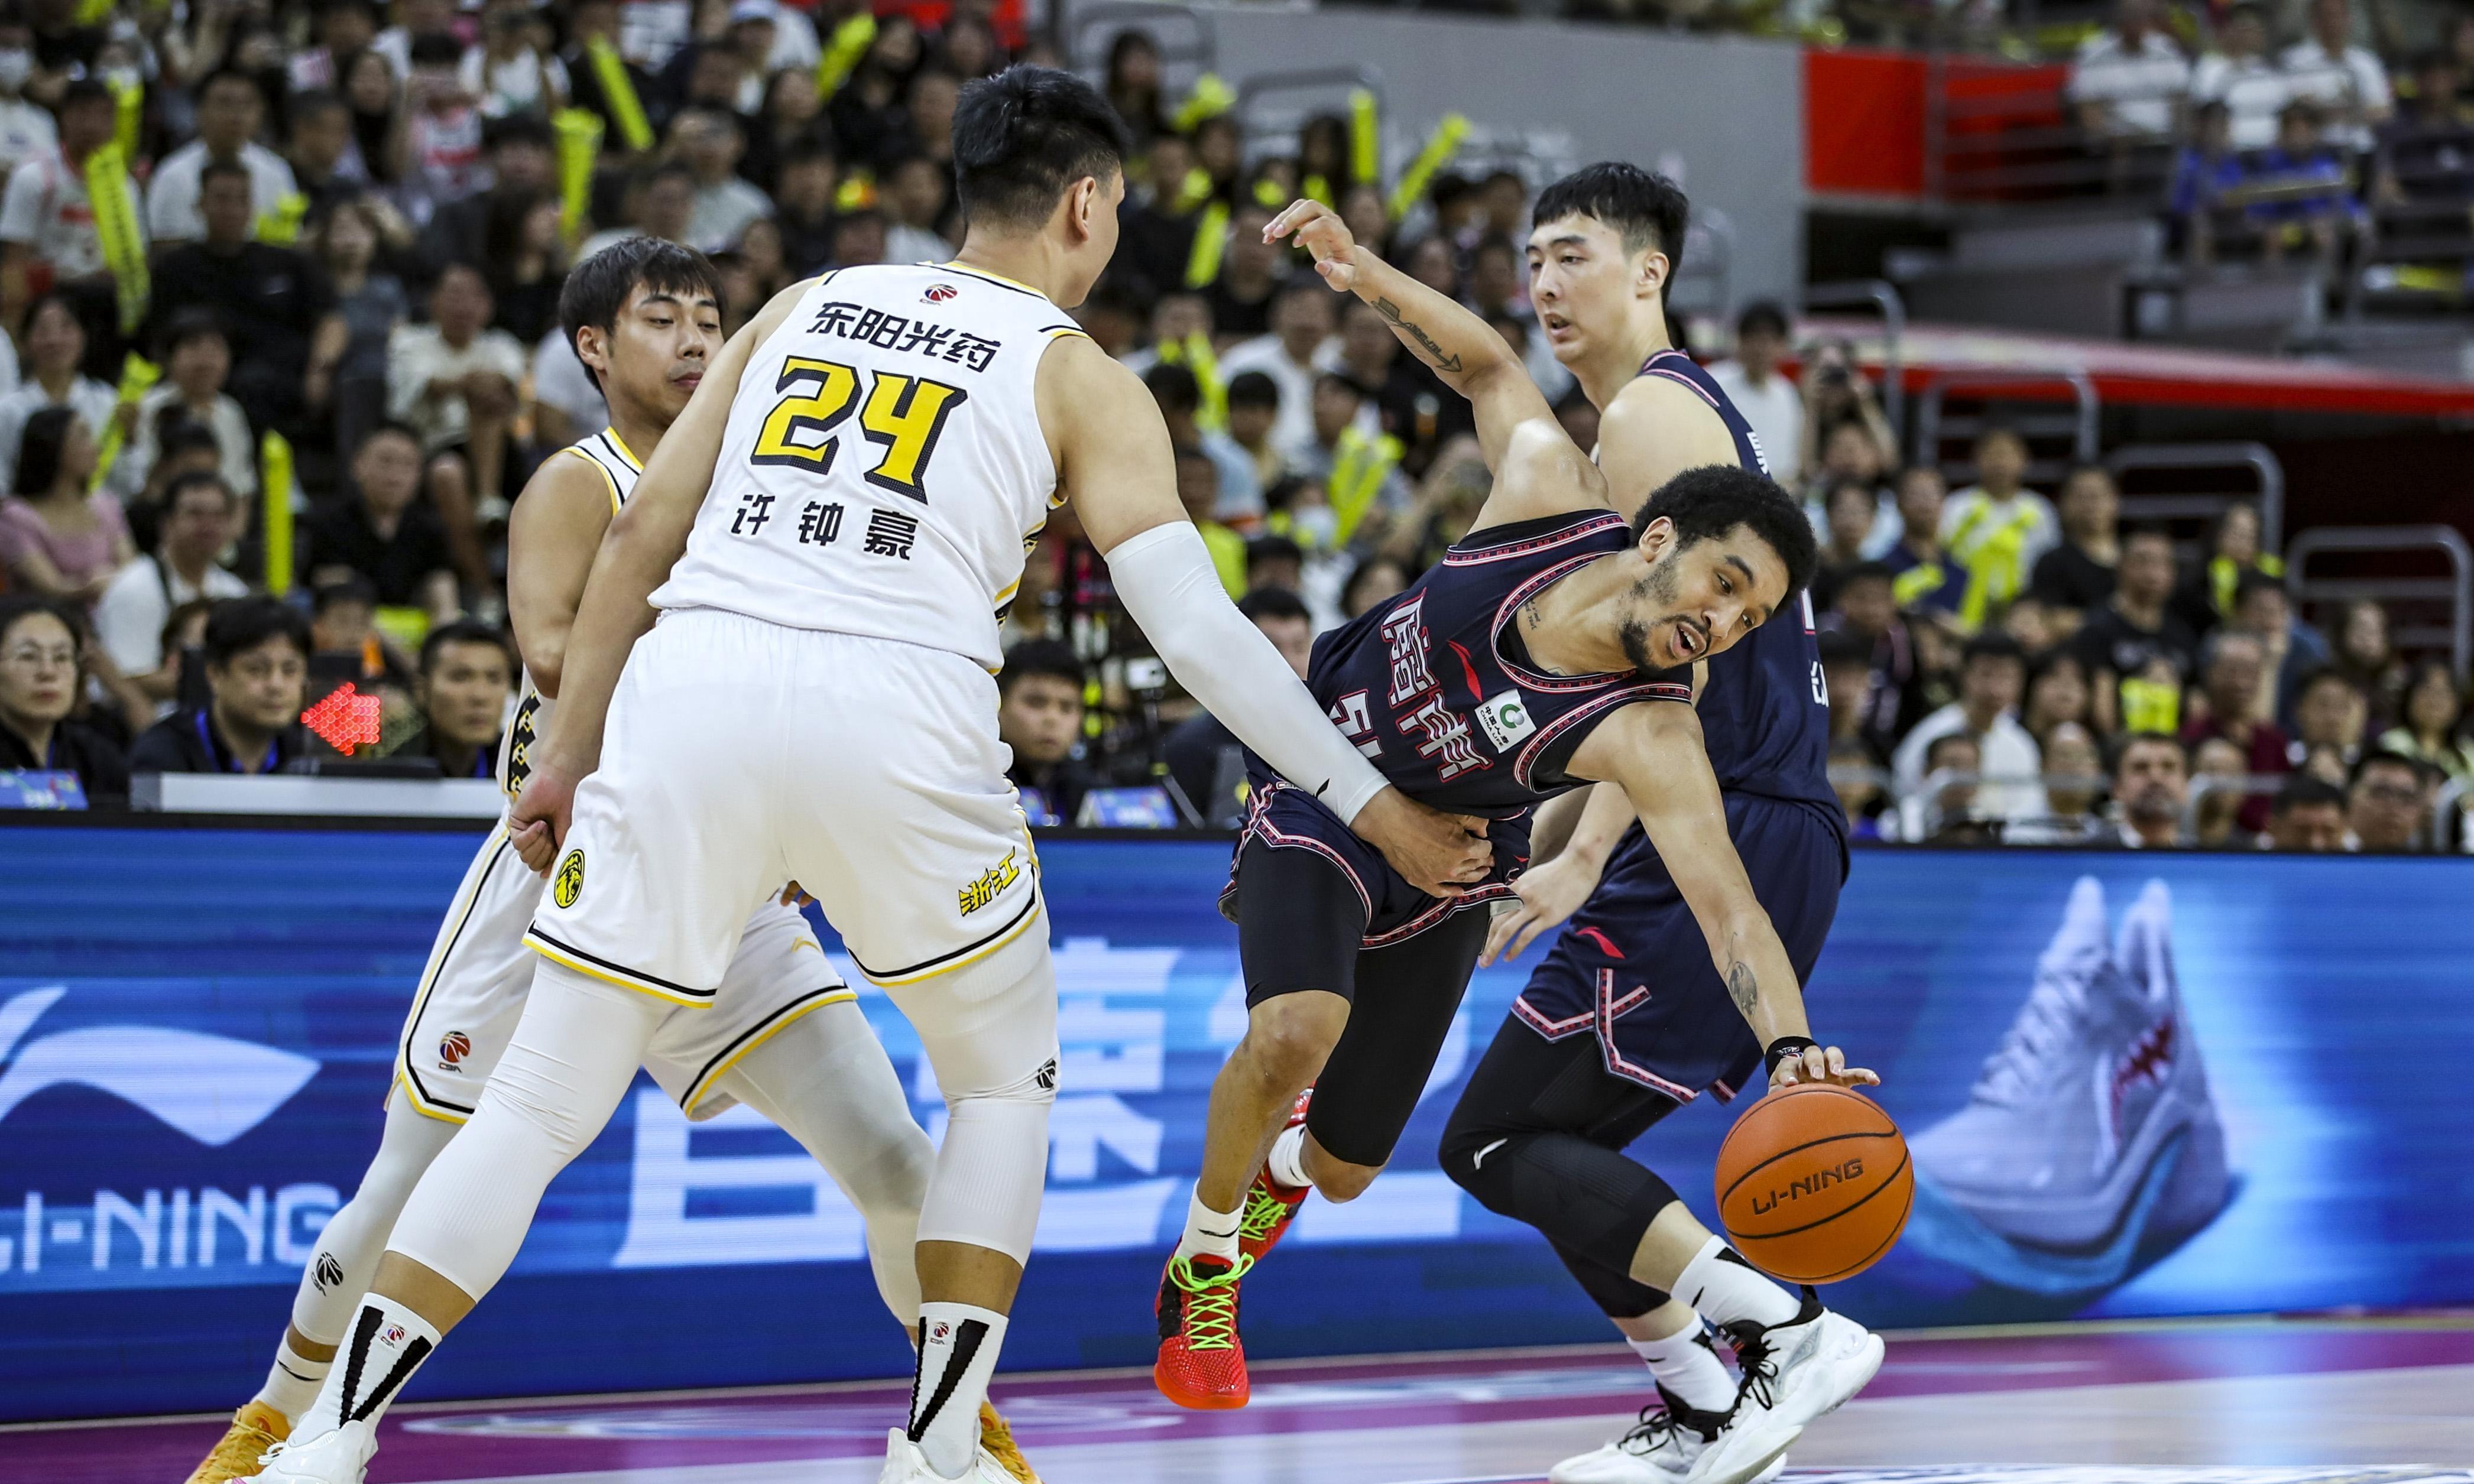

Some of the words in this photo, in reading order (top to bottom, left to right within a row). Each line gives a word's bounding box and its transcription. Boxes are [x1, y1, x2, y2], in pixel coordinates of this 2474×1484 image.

[806, 301, 1002, 373] 东阳光药
[750, 355, 968, 505] 24
[731, 493, 919, 561] 许钟豪
[1480, 709, 1493, 732] CHINA
[1492, 733, 1504, 746] LIFE
[1485, 706, 1509, 744] 中国人寿
[958, 845, 1020, 917] 浙江
[439, 1062, 463, 1073] CBA
[1752, 1157, 1864, 1215] LI-NING
[0, 1182, 341, 1274] I-NING
[311, 1272, 327, 1297] CBA
